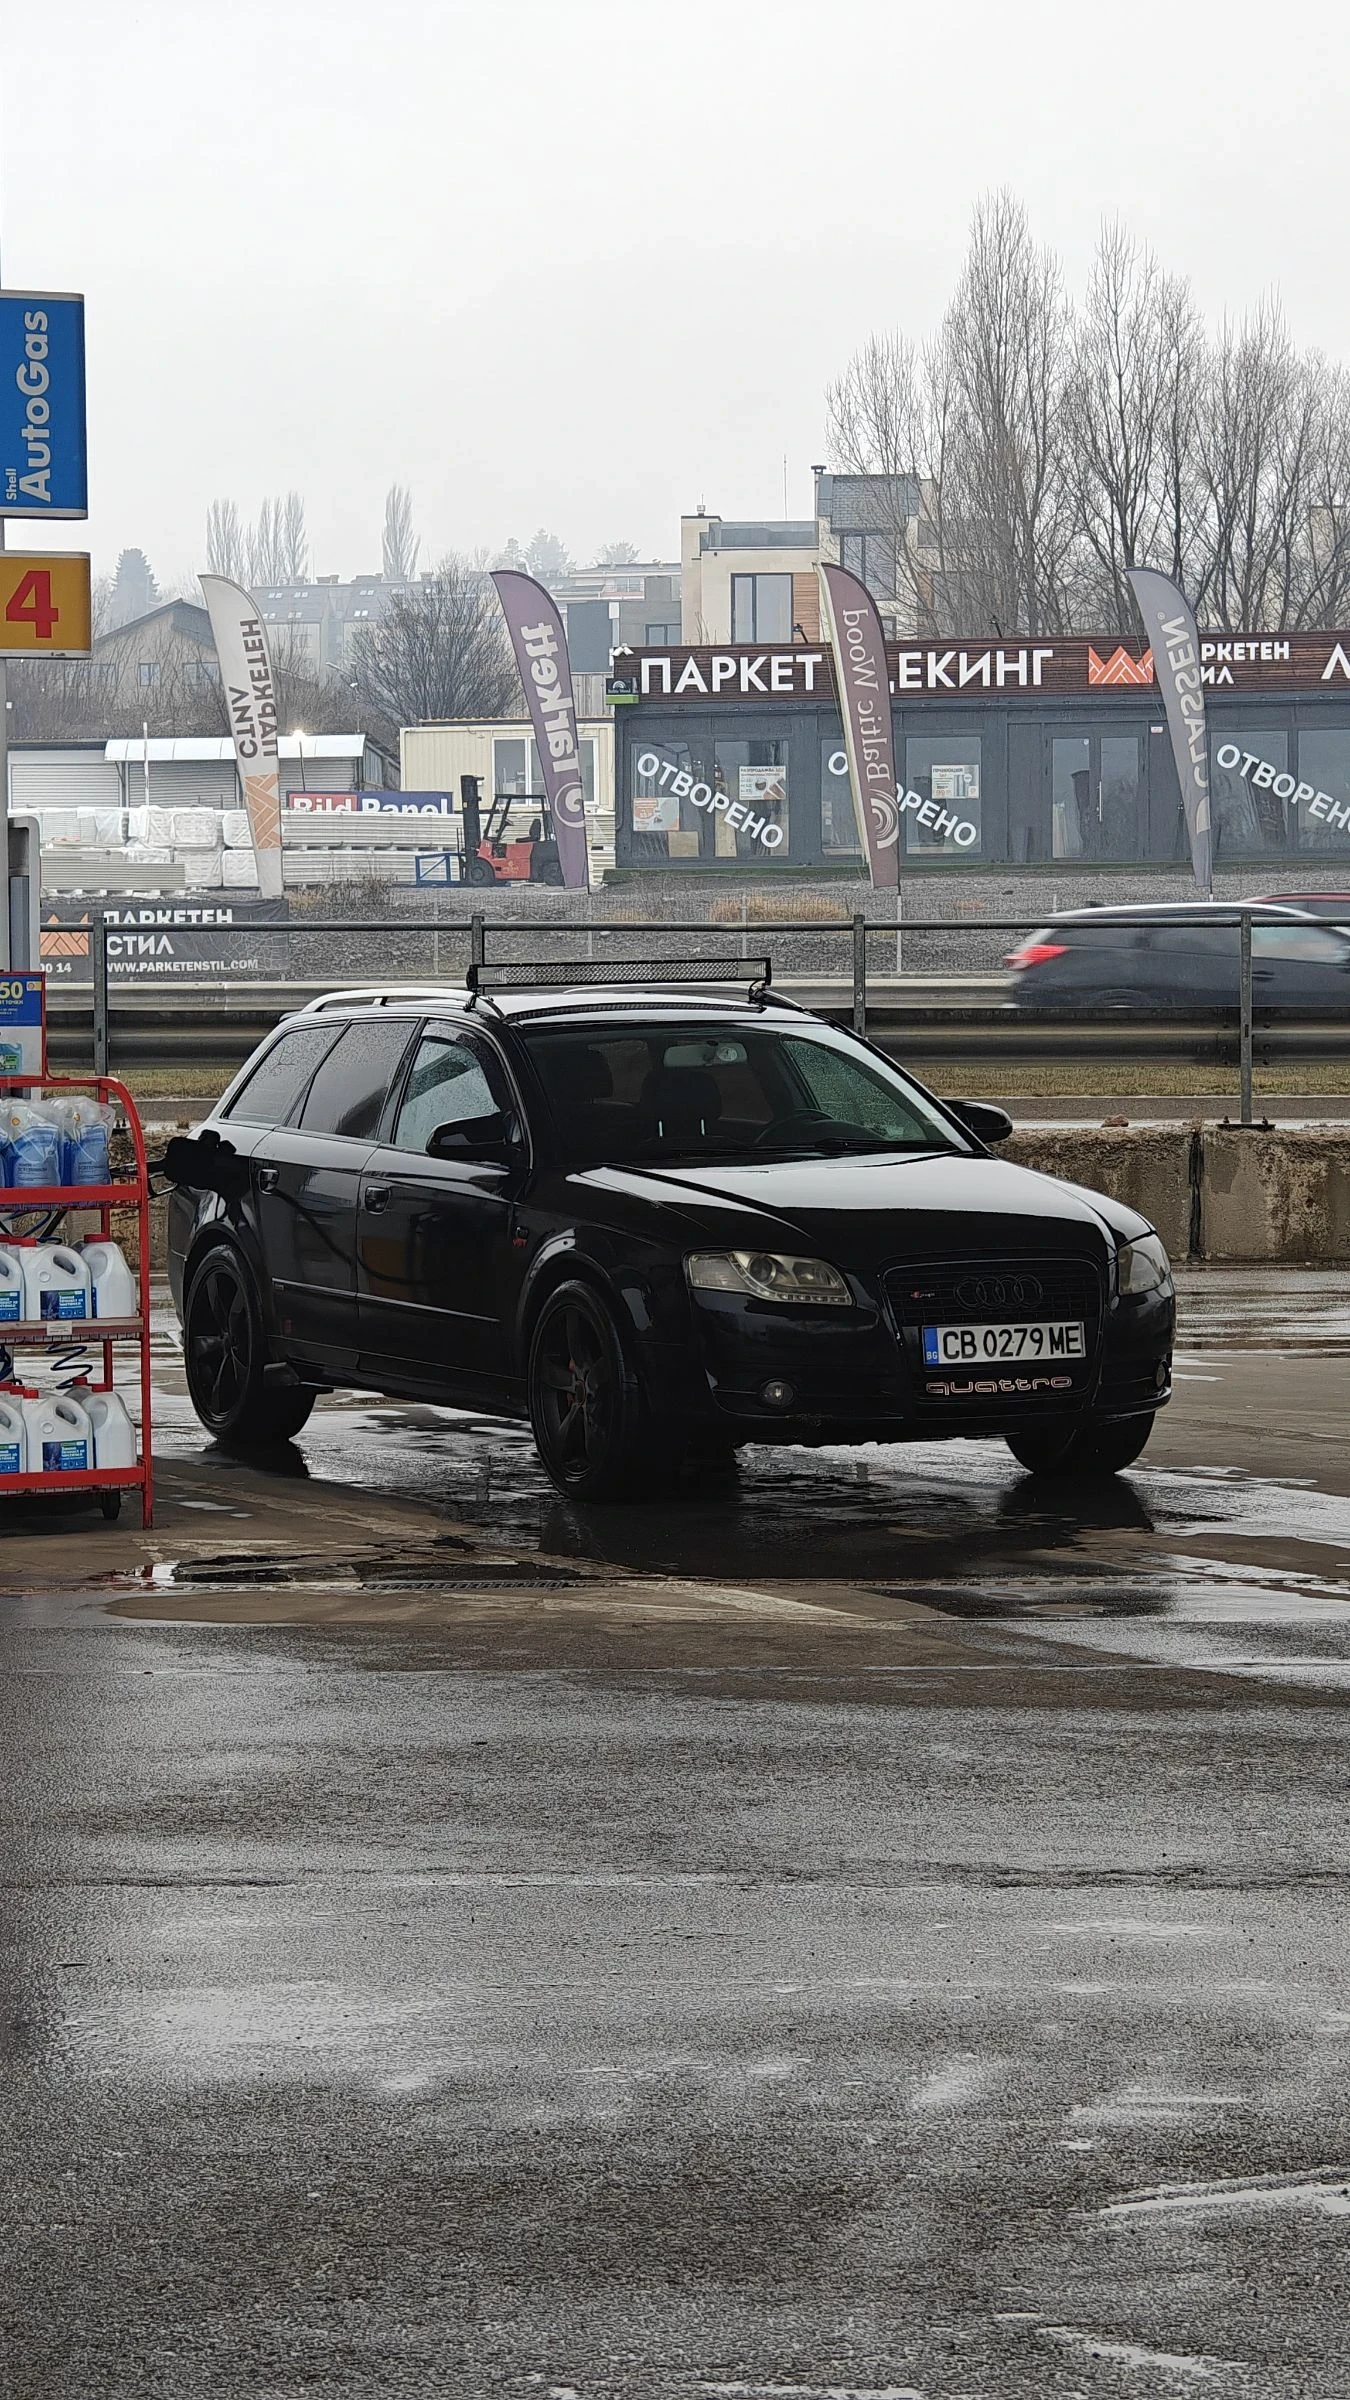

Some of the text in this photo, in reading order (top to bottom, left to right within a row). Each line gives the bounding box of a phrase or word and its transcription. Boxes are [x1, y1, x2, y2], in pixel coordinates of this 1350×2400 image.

[16, 310, 51, 503] AutoGas
[6, 467, 17, 501] Shell
[5, 569, 59, 639] 4
[1201, 641, 1290, 661] РКЕТЕН
[641, 650, 1053, 694] ПАРКЕТ ЕКИНГ
[637, 753, 784, 849] ОТВОРЕНО
[1217, 744, 1350, 834] ОТВОРЕН
[107, 935, 174, 955] СТИЛ
[56, 962, 73, 973] 14
[926, 1351, 938, 1361] BG
[943, 1325, 1082, 1360] CB 0279 ME
[926, 1376, 1073, 1396] quattro
